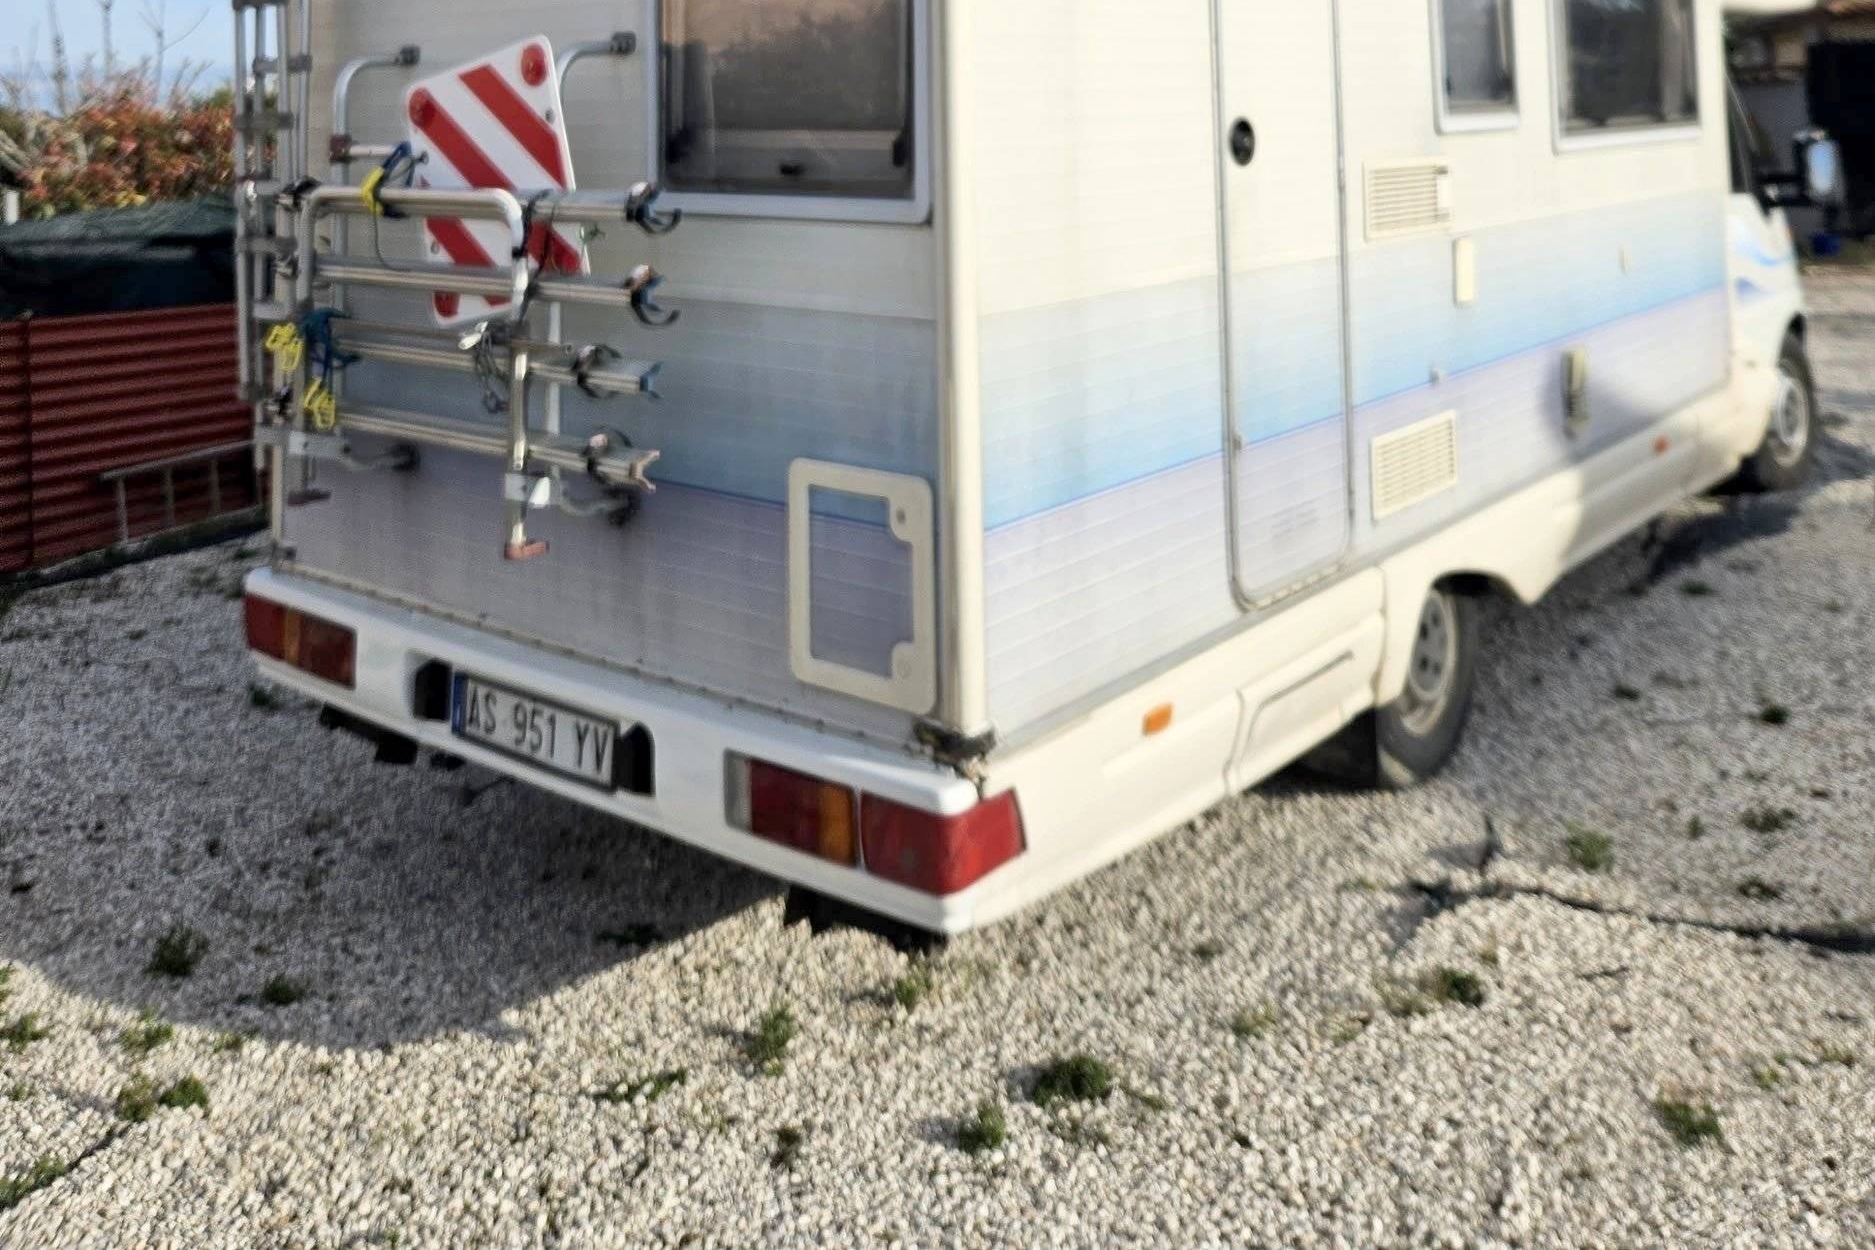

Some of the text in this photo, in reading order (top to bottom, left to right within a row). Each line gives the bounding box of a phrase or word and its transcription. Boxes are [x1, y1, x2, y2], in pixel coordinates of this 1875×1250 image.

[468, 686, 497, 736] AS
[512, 701, 557, 759] 951
[575, 720, 611, 776] YV
